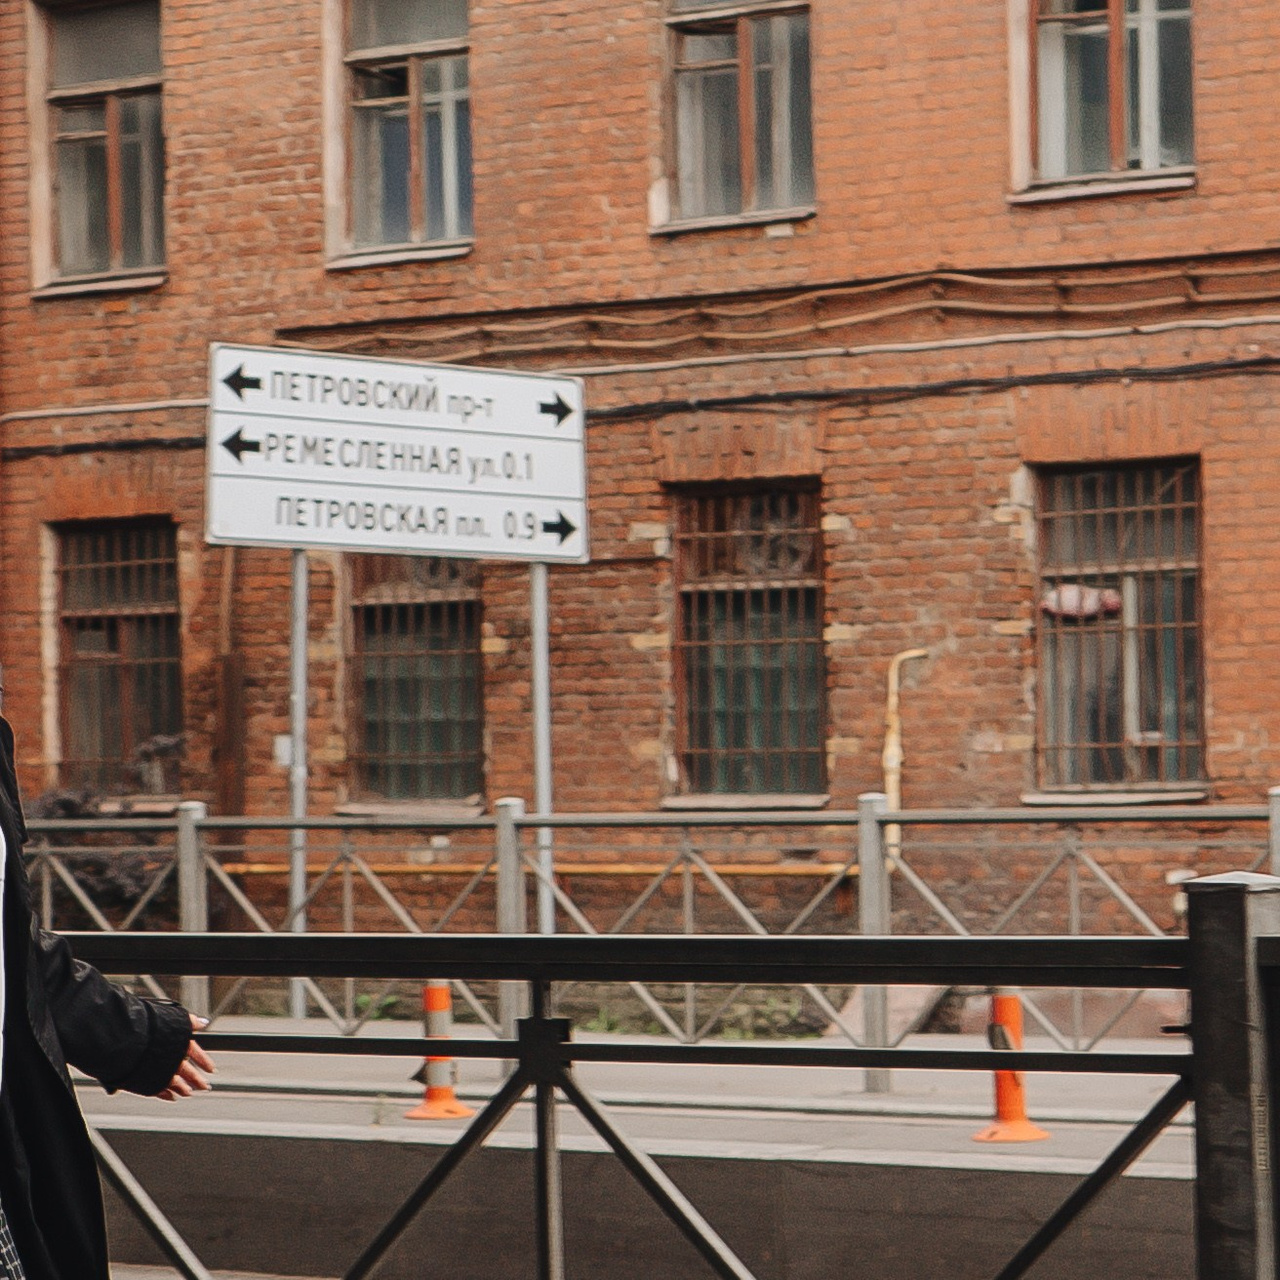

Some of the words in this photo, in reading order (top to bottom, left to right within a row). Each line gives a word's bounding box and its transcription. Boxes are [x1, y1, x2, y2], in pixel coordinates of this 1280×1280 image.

[270, 371, 439, 413] ПЕТРОВСКИЙ
[447, 394, 495, 423] пр-т
[265, 433, 462, 475] РЕМЕСЛЕННАЯ
[276, 496, 449, 536] ПЕТРОВСКАЯ
[503, 509, 536, 540] 0.9
